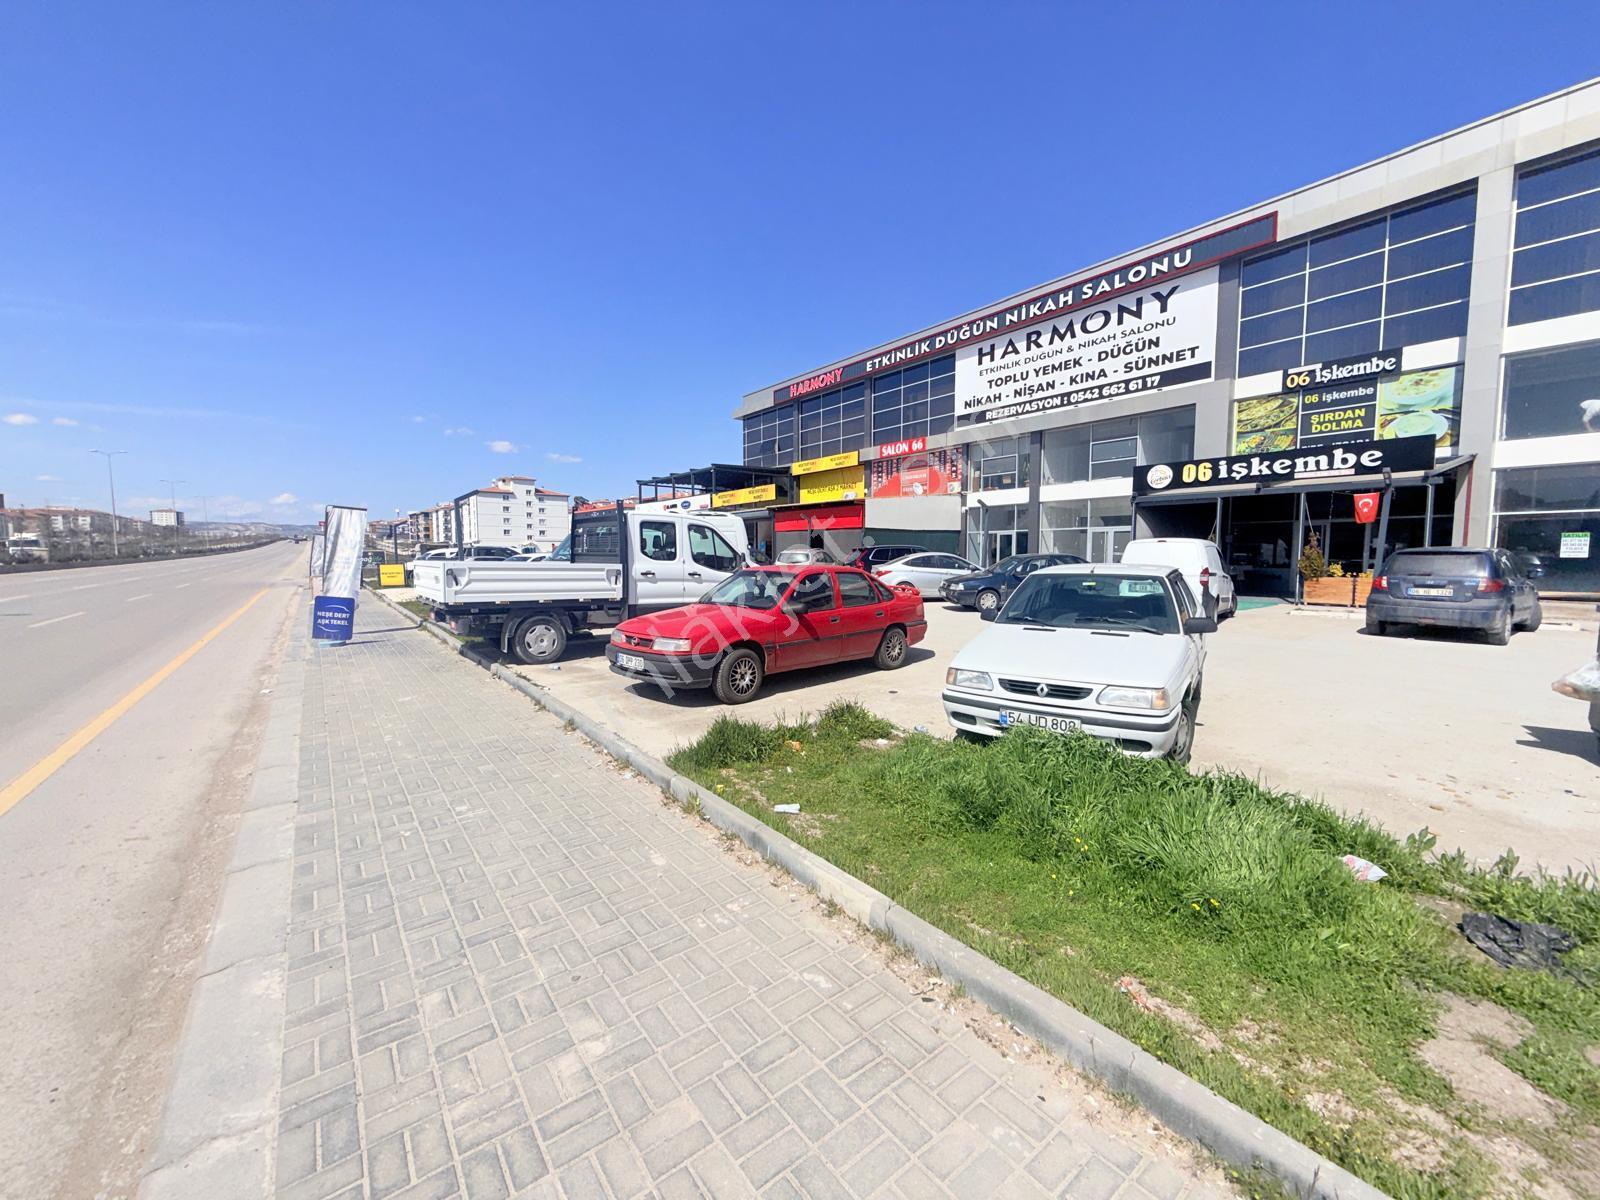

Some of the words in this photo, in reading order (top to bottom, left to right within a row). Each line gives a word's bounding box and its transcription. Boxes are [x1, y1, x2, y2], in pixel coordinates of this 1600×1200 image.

[866, 341, 931, 372] ETKİNLİK
[935, 317, 998, 349] DÜĞÜN
[1005, 290, 1073, 326] NİKAH
[1081, 248, 1193, 300] SALONU
[977, 285, 1181, 367] HARMONY
[1066, 345, 1074, 353] &
[1120, 316, 1176, 339] SALONU
[964, 392, 1002, 409] NİKAH
[1013, 380, 1056, 398] NİŞAN
[1069, 368, 1108, 386] KINA
[1123, 345, 1200, 374] SÜNNET
[987, 370, 1030, 389] TOPLU
[1033, 356, 1083, 378] YEMEK
[1097, 336, 1161, 362] DÜĞÜN
[789, 367, 844, 397] HARMONY
[1286, 371, 1311, 389] 06
[985, 396, 1061, 420] REZERVASYON
[1069, 389, 1100, 403] 0542
[1101, 382, 1126, 396] 662
[1128, 378, 1143, 390] 61
[1145, 375, 1161, 387] 17
[1304, 393, 1319, 404] 06
[1310, 407, 1366, 424] ŞIRDAN
[1311, 419, 1364, 433] DOLMA
[881, 441, 909, 457] SALON
[911, 439, 923, 451] 66
[1182, 462, 1213, 484] 06
[1218, 448, 1384, 481] işkembe
[1008, 712, 1023, 724] 54
[1028, 714, 1048, 728] UD
